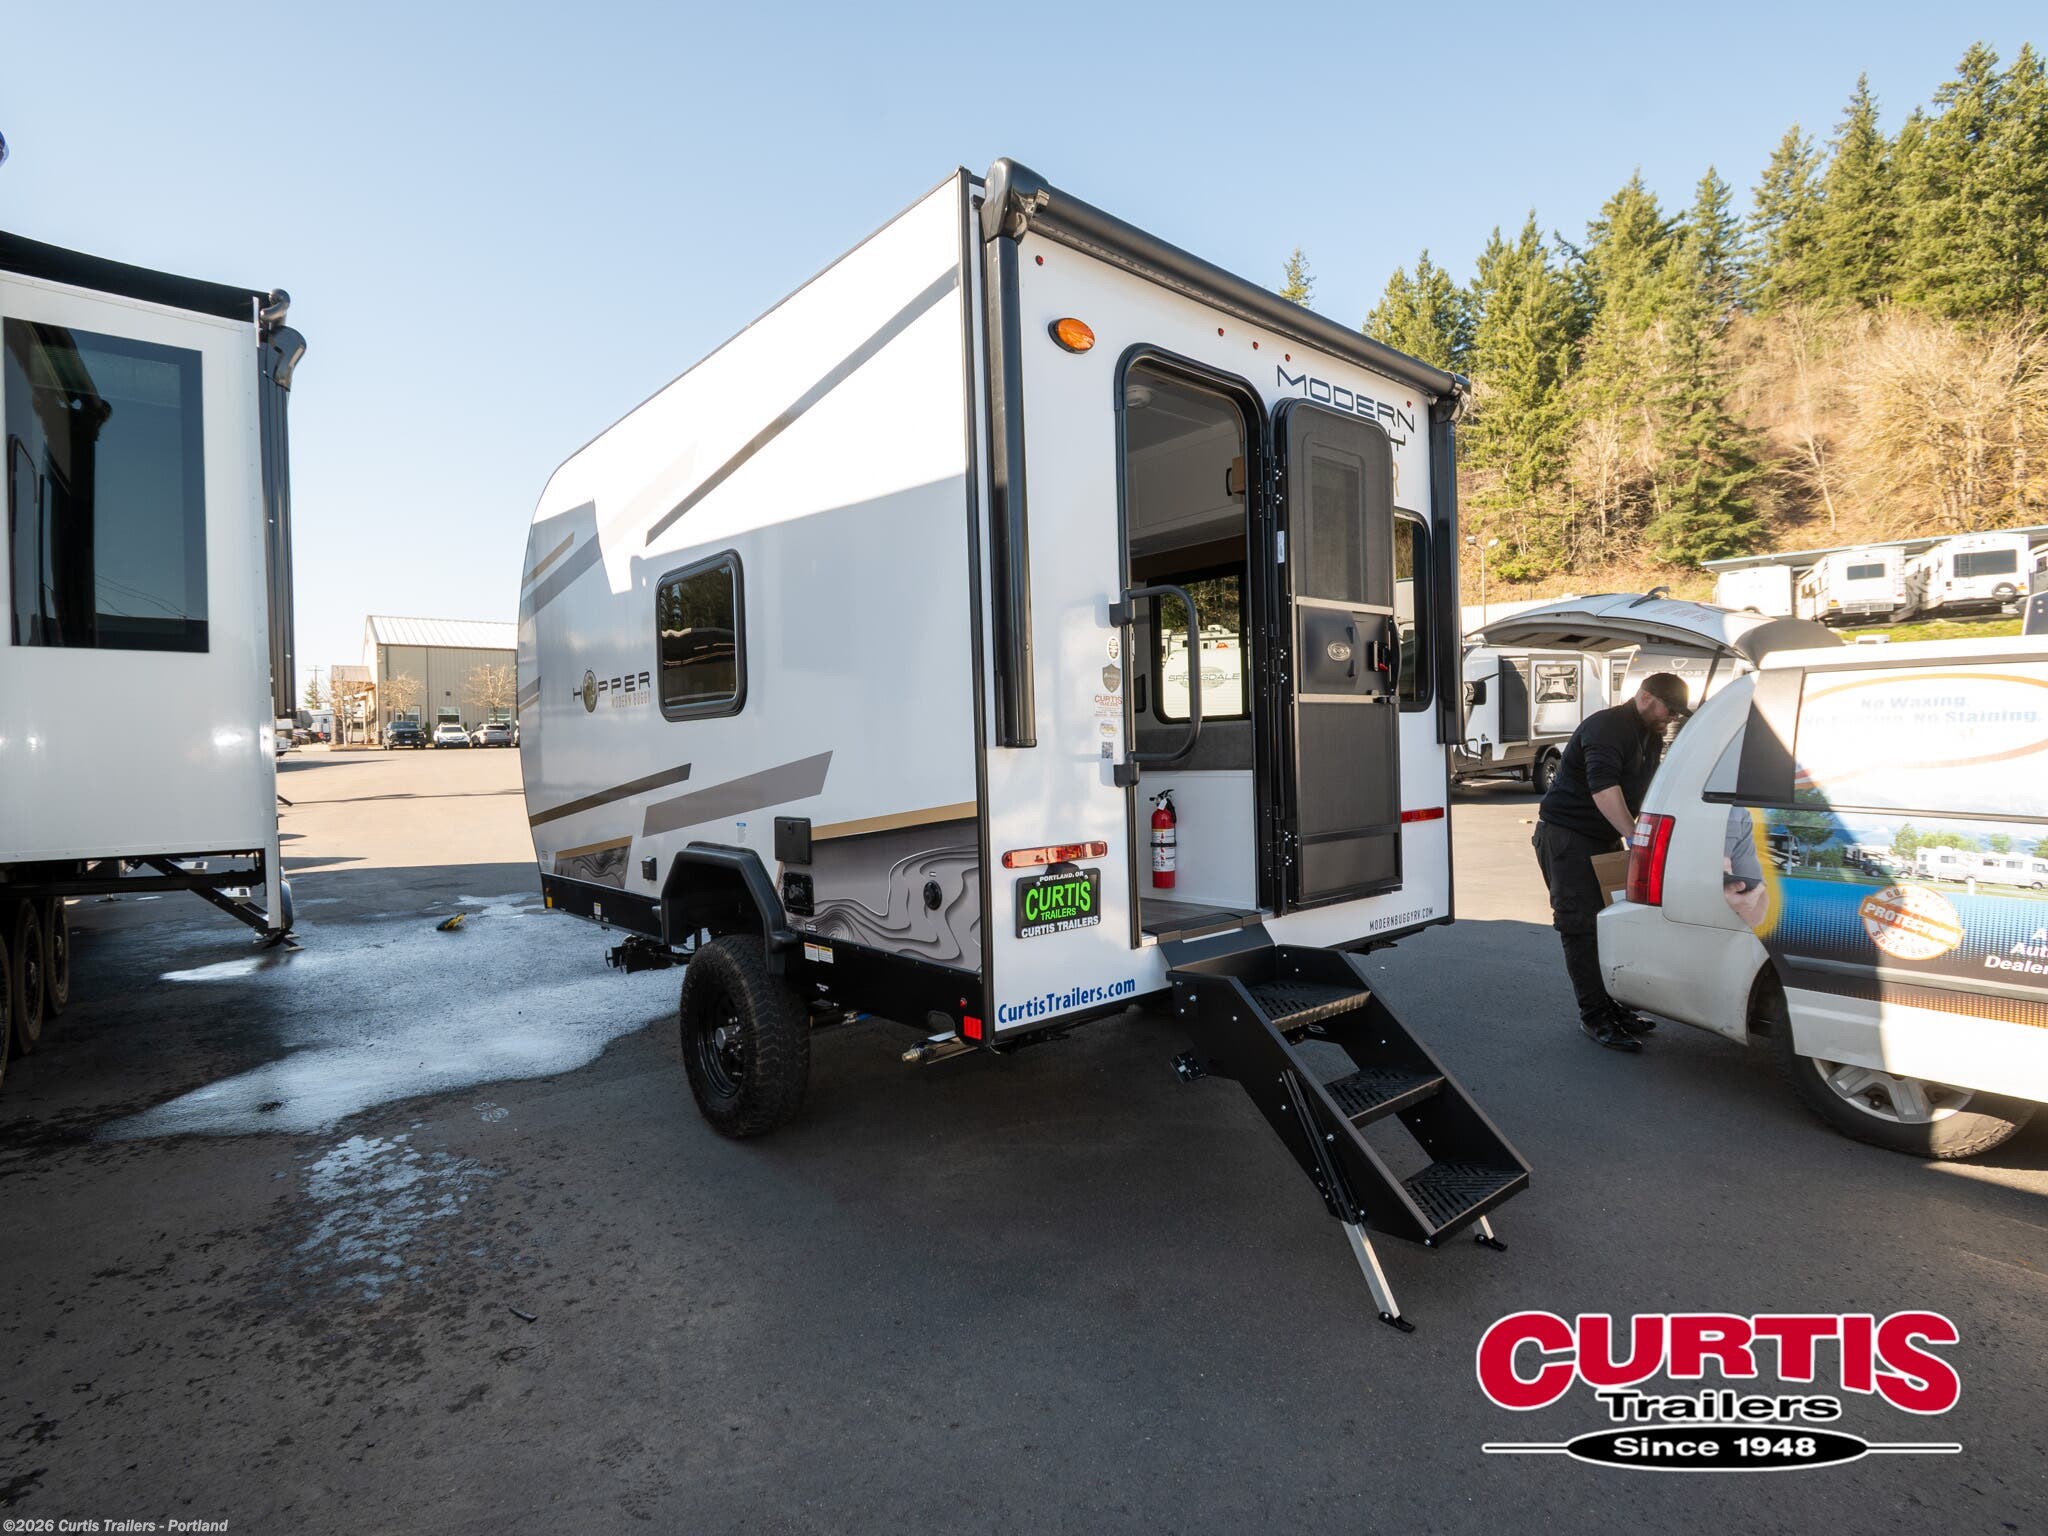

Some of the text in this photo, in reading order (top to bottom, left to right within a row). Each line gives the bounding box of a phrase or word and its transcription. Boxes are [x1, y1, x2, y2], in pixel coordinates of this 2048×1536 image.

[1277, 364, 1415, 433] MODERN
[1168, 673, 1241, 682] SPRGDALE
[573, 671, 650, 712] HOPPER
[1075, 870, 1085, 878] OR
[1025, 881, 1091, 921] CURTIS
[1021, 915, 1099, 938] CURTIS TRAILERS
[1040, 907, 1077, 921] TRAILERS
[1369, 906, 1434, 931] MODERNBUGGYRV.COM
[998, 978, 1136, 1023] CurtisTrailers.com
